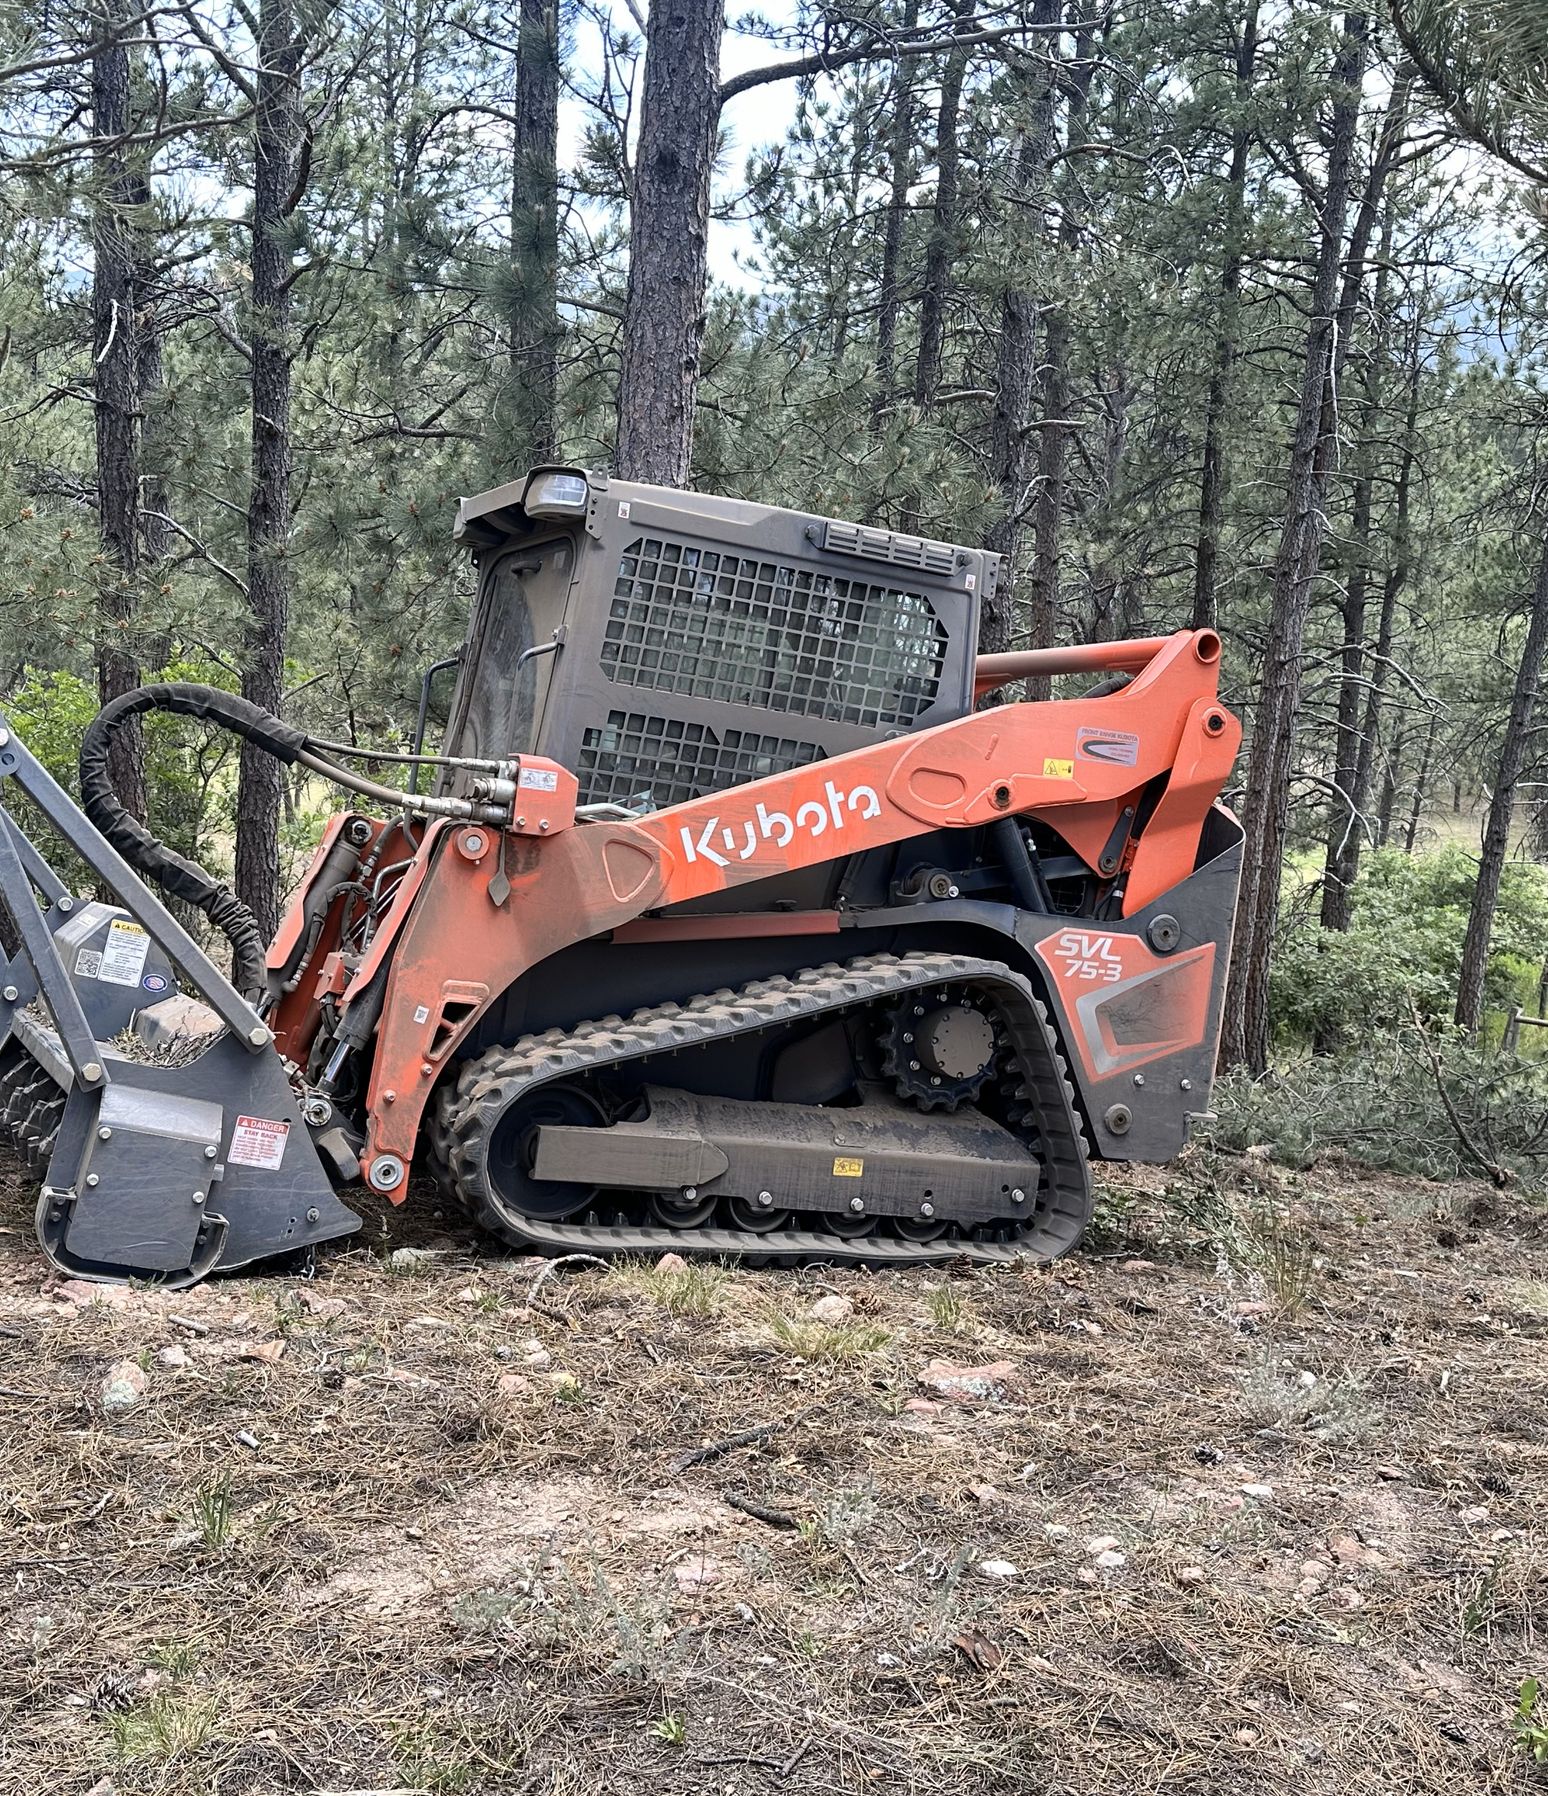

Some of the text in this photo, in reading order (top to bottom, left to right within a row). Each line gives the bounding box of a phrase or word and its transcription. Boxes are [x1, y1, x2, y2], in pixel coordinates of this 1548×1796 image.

[680, 780, 882, 867] Kubota
[121, 924, 147, 934] CAUTIO
[1054, 934, 1121, 961] SVL
[1064, 959, 1122, 981] 75-3
[244, 1129, 259, 1137] STAY
[250, 1120, 285, 1133] DANGER
